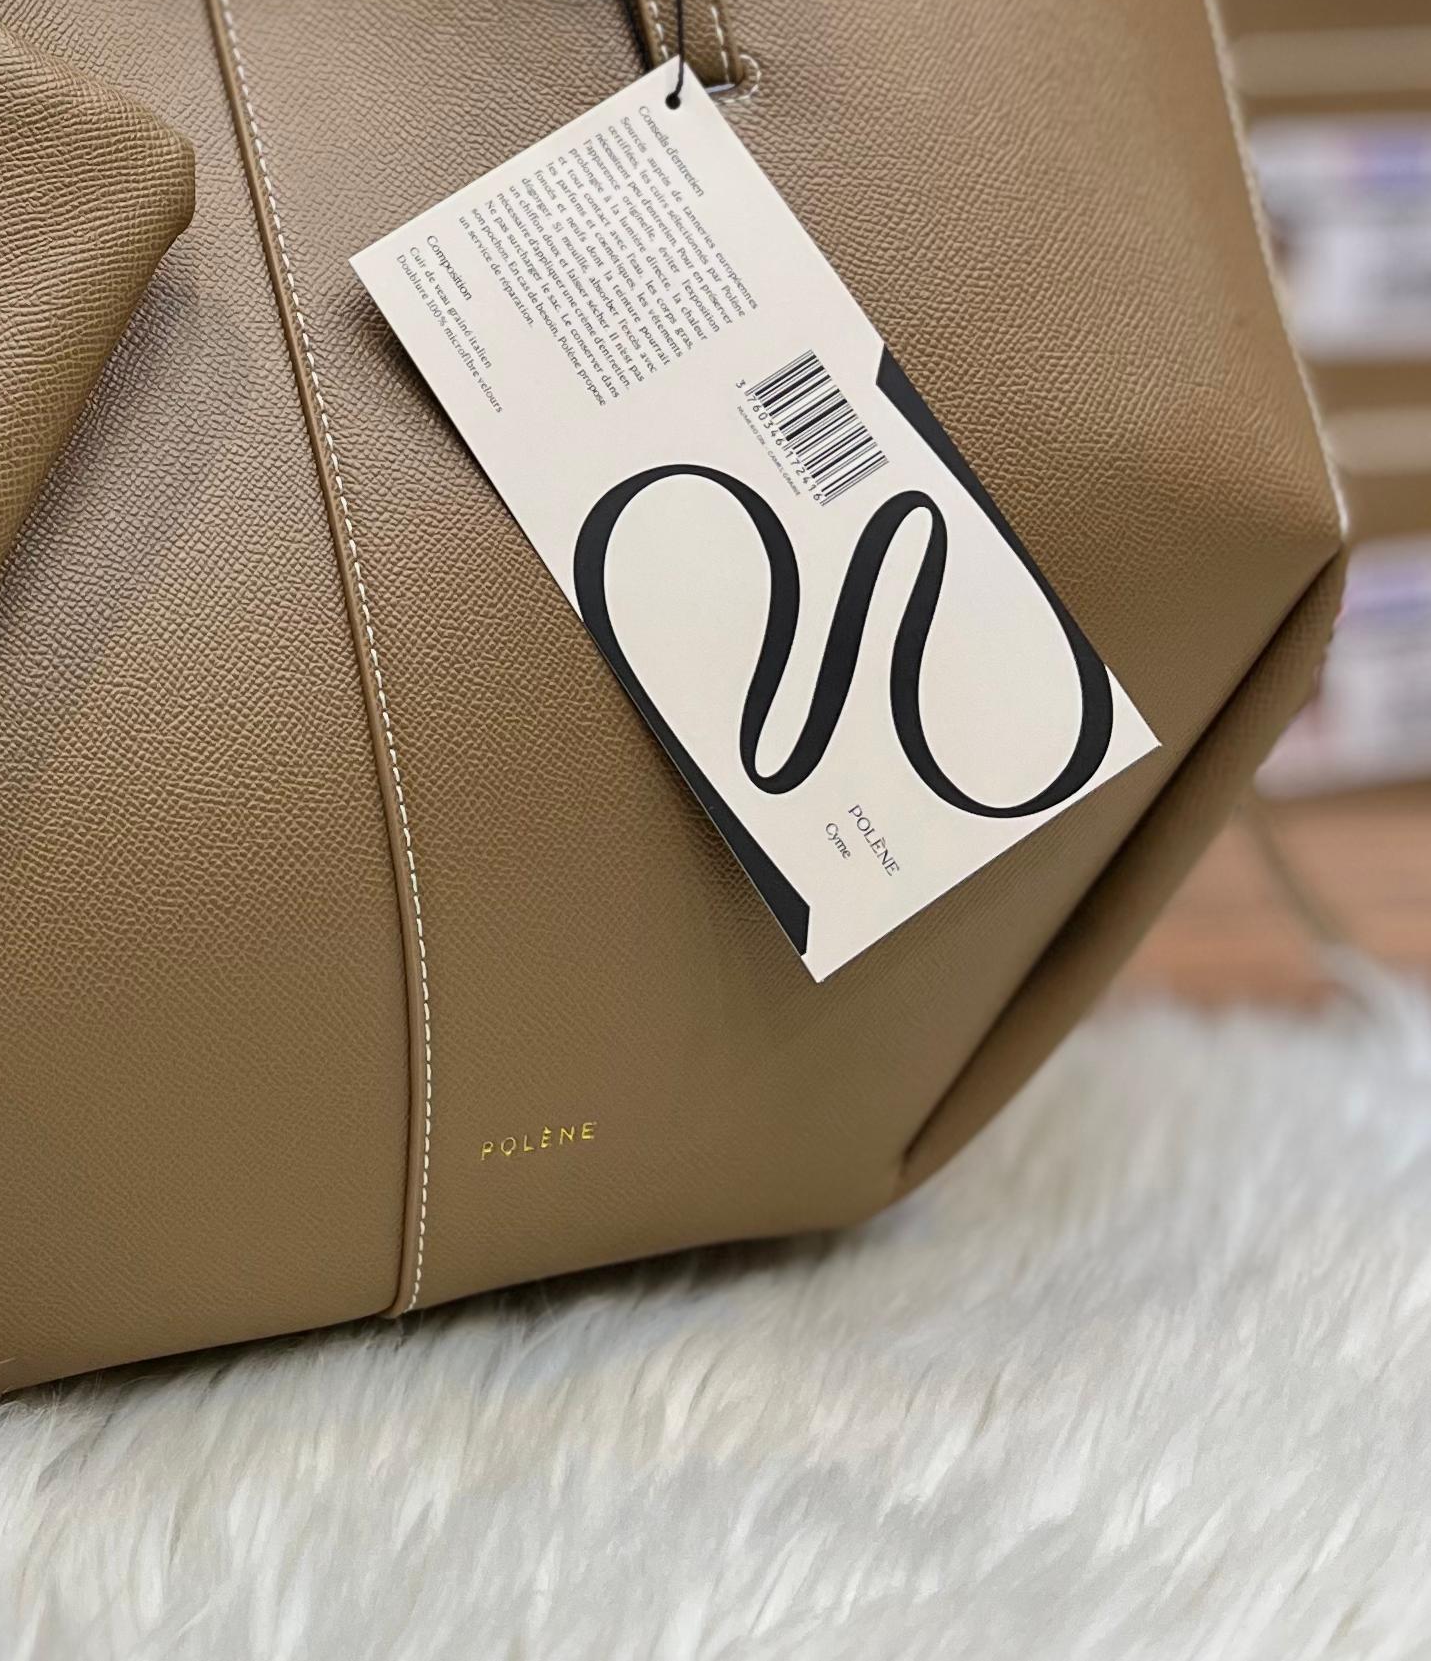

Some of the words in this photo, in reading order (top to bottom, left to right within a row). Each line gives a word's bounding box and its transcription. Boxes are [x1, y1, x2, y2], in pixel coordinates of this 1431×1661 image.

[620, 116, 647, 153] Sourcés
[670, 189, 683, 203] de
[682, 205, 716, 249] tanneries
[714, 252, 758, 310] européennes
[638, 105, 669, 148] Conseils
[665, 147, 704, 197] d'entretien
[409, 246, 427, 269] Cuir
[423, 269, 436, 284] de
[433, 283, 451, 306] veau
[445, 306, 474, 337] grainé
[467, 335, 492, 369] italien
[426, 234, 473, 301] Composition
[458, 215, 470, 230] un
[467, 230, 493, 263] service
[489, 262, 502, 276] de
[471, 207, 486, 226] son
[507, 260, 520, 276] En
[516, 275, 531, 292] cas
[526, 291, 539, 305] de
[556, 335, 582, 369] Polène
[575, 368, 607, 407] propose
[484, 199, 497, 216] Ne
[492, 216, 510, 233] pas
[506, 233, 543, 282] surcharger
[540, 281, 551, 294] le
[559, 312, 572, 327] Le
[569, 328, 604, 373] conserver
[600, 374, 620, 398] dans
[496, 192, 531, 239] nécessaire
[527, 238, 567, 290] d'appliquer
[561, 288, 578, 309] une
[508, 185, 521, 199] un
[518, 199, 545, 233] chiffon
[541, 233, 562, 258] doux
[558, 257, 569, 269] et
[565, 267, 589, 298] laisser
[608, 331, 620, 342] Il
[627, 364, 645, 382] pas
[533, 169, 557, 201] foncés
[555, 202, 567, 213] et
[565, 216, 587, 243] neufs
[585, 244, 605, 268] dont
[602, 269, 613, 283] la
[611, 283, 642, 324] teinture
[637, 325, 671, 366] pourrait
[546, 160, 558, 177] les
[555, 179, 587, 217] parfums
[585, 218, 596, 230] et
[635, 291, 649, 308] les
[647, 308, 684, 358] vêtements
[551, 221, 564, 233] Si
[587, 275, 620, 317] absorber
[617, 317, 642, 351] l'excès
[639, 351, 658, 374] avec
[557, 155, 568, 166] et
[566, 168, 585, 190] tout
[583, 192, 611, 227] contact
[608, 229, 628, 251] avec
[644, 279, 658, 296] les
[655, 297, 678, 325] corps
[567, 147, 604, 193] prolongée
[602, 195, 612, 204] à
[609, 203, 620, 216] la
[618, 215, 647, 253] lumière
[671, 291, 682, 305] la
[680, 306, 708, 341] chaleur
[582, 138, 621, 191] l'apparence
[657, 246, 680, 274] éviter
[680, 278, 720, 333] l'exposition
[626, 180, 644, 198] peu
[675, 246, 695, 269] Pour
[692, 270, 704, 284] en
[698, 283, 733, 324] préserver
[639, 169, 652, 185] les
[649, 184, 669, 209] cuirs
[666, 209, 709, 266] sélectionnés
[705, 266, 723, 283] par
[720, 284, 746, 317] Polène
[396, 253, 429, 300] Doublure
[425, 298, 448, 327] 100%
[476, 376, 503, 413] velours
[825, 823, 851, 859] Cyme
[848, 804, 900, 876] POLÈNE
[480, 1121, 598, 1160] POLÈNE
